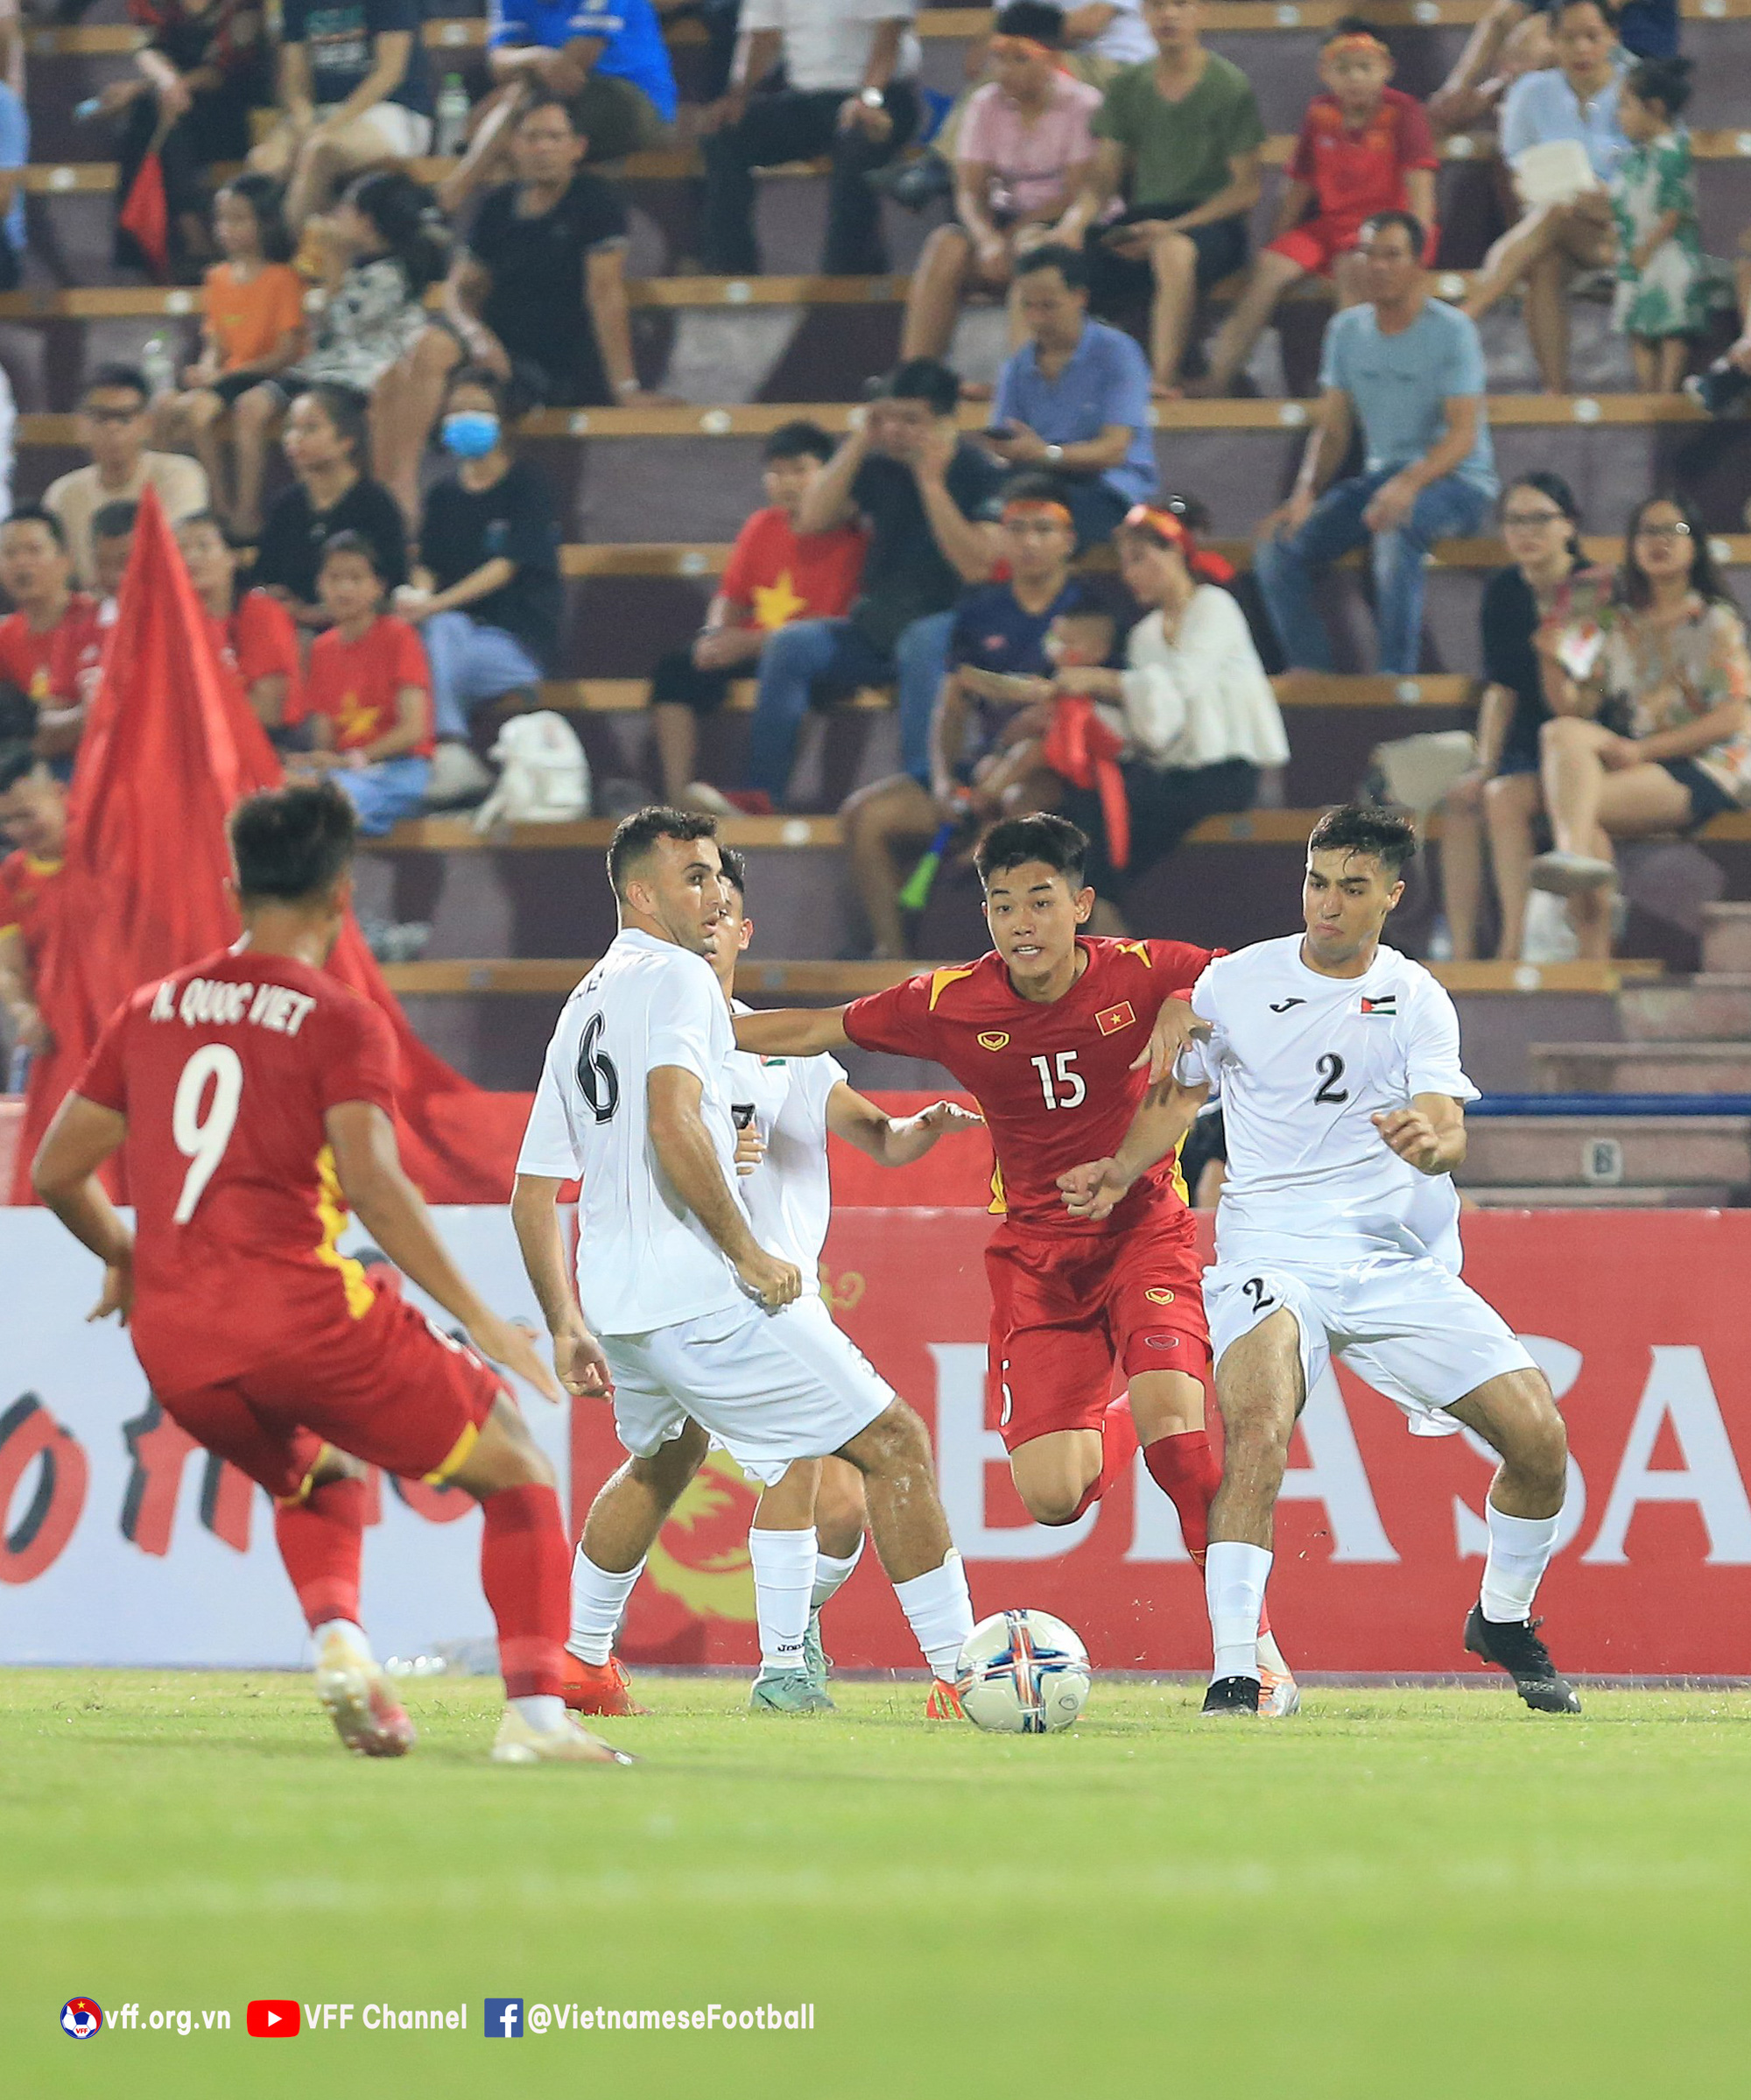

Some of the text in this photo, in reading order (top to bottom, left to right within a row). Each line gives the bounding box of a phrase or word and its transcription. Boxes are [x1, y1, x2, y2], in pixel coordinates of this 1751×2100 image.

[574, 1009, 622, 1125] 6
[1030, 1050, 1086, 1110] 15
[1315, 1052, 1349, 1105] 2
[172, 1043, 244, 1224] 9
[1241, 1277, 1276, 1315] 2
